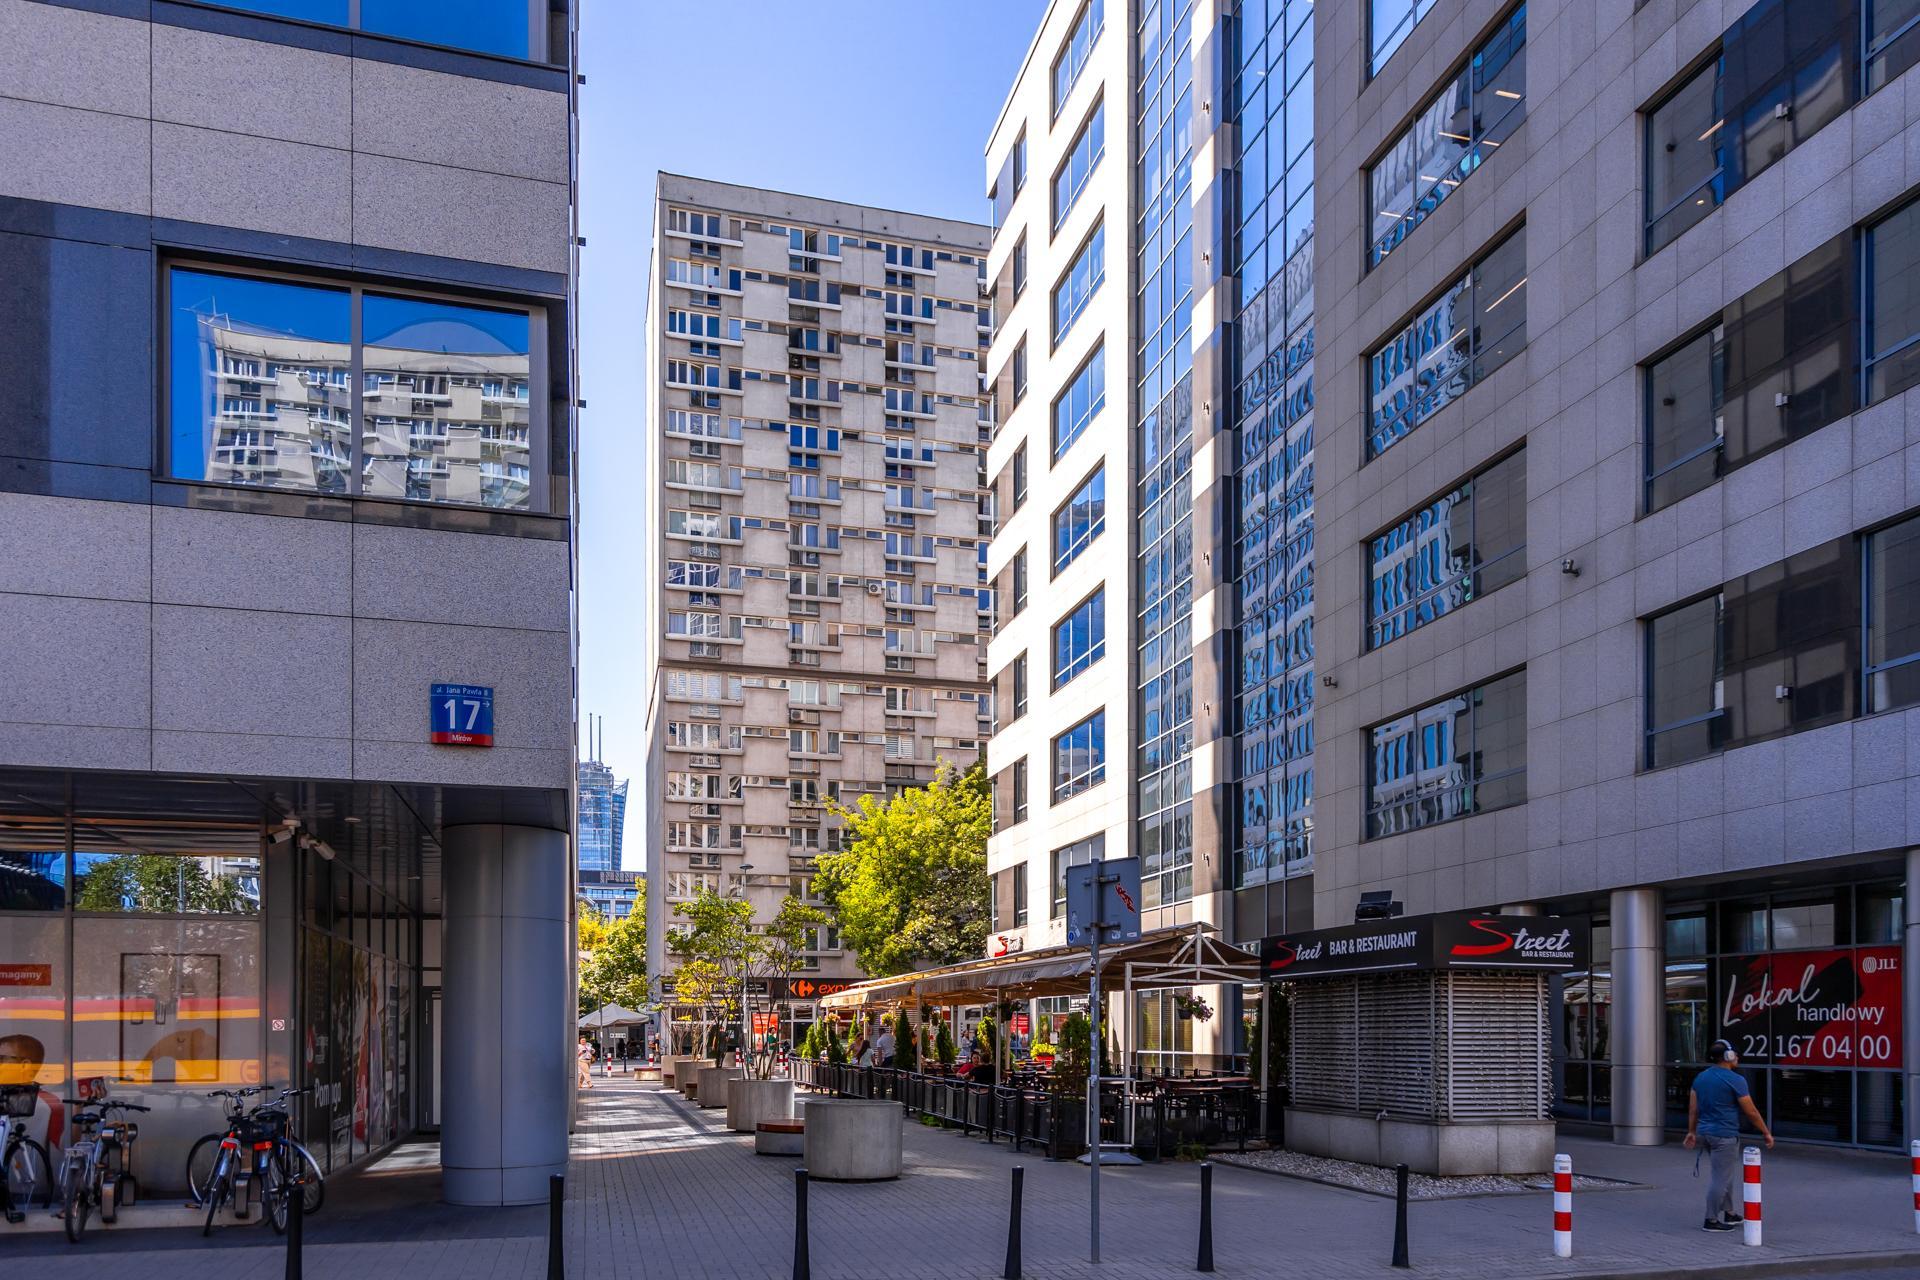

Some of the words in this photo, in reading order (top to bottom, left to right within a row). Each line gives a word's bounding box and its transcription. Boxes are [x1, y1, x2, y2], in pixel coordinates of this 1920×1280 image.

[446, 686, 460, 694] Jana
[462, 687, 482, 696] Pawła
[443, 699, 481, 730] 17
[452, 734, 473, 742] Mirów
[1270, 940, 1322, 969] Street
[1329, 941, 1347, 955] BAR
[1349, 941, 1355, 953] &
[1356, 931, 1417, 952] RESTAURANT
[1450, 919, 1571, 956] Street
[1877, 958, 1897, 969] JLL
[1723, 964, 1820, 1027] Lokal
[1797, 1003, 1885, 1025] handlowy
[1743, 1034, 1768, 1057] 22
[1775, 1035, 1816, 1058] 167
[1822, 1035, 1852, 1059] 04
[1860, 1035, 1891, 1060] 00
